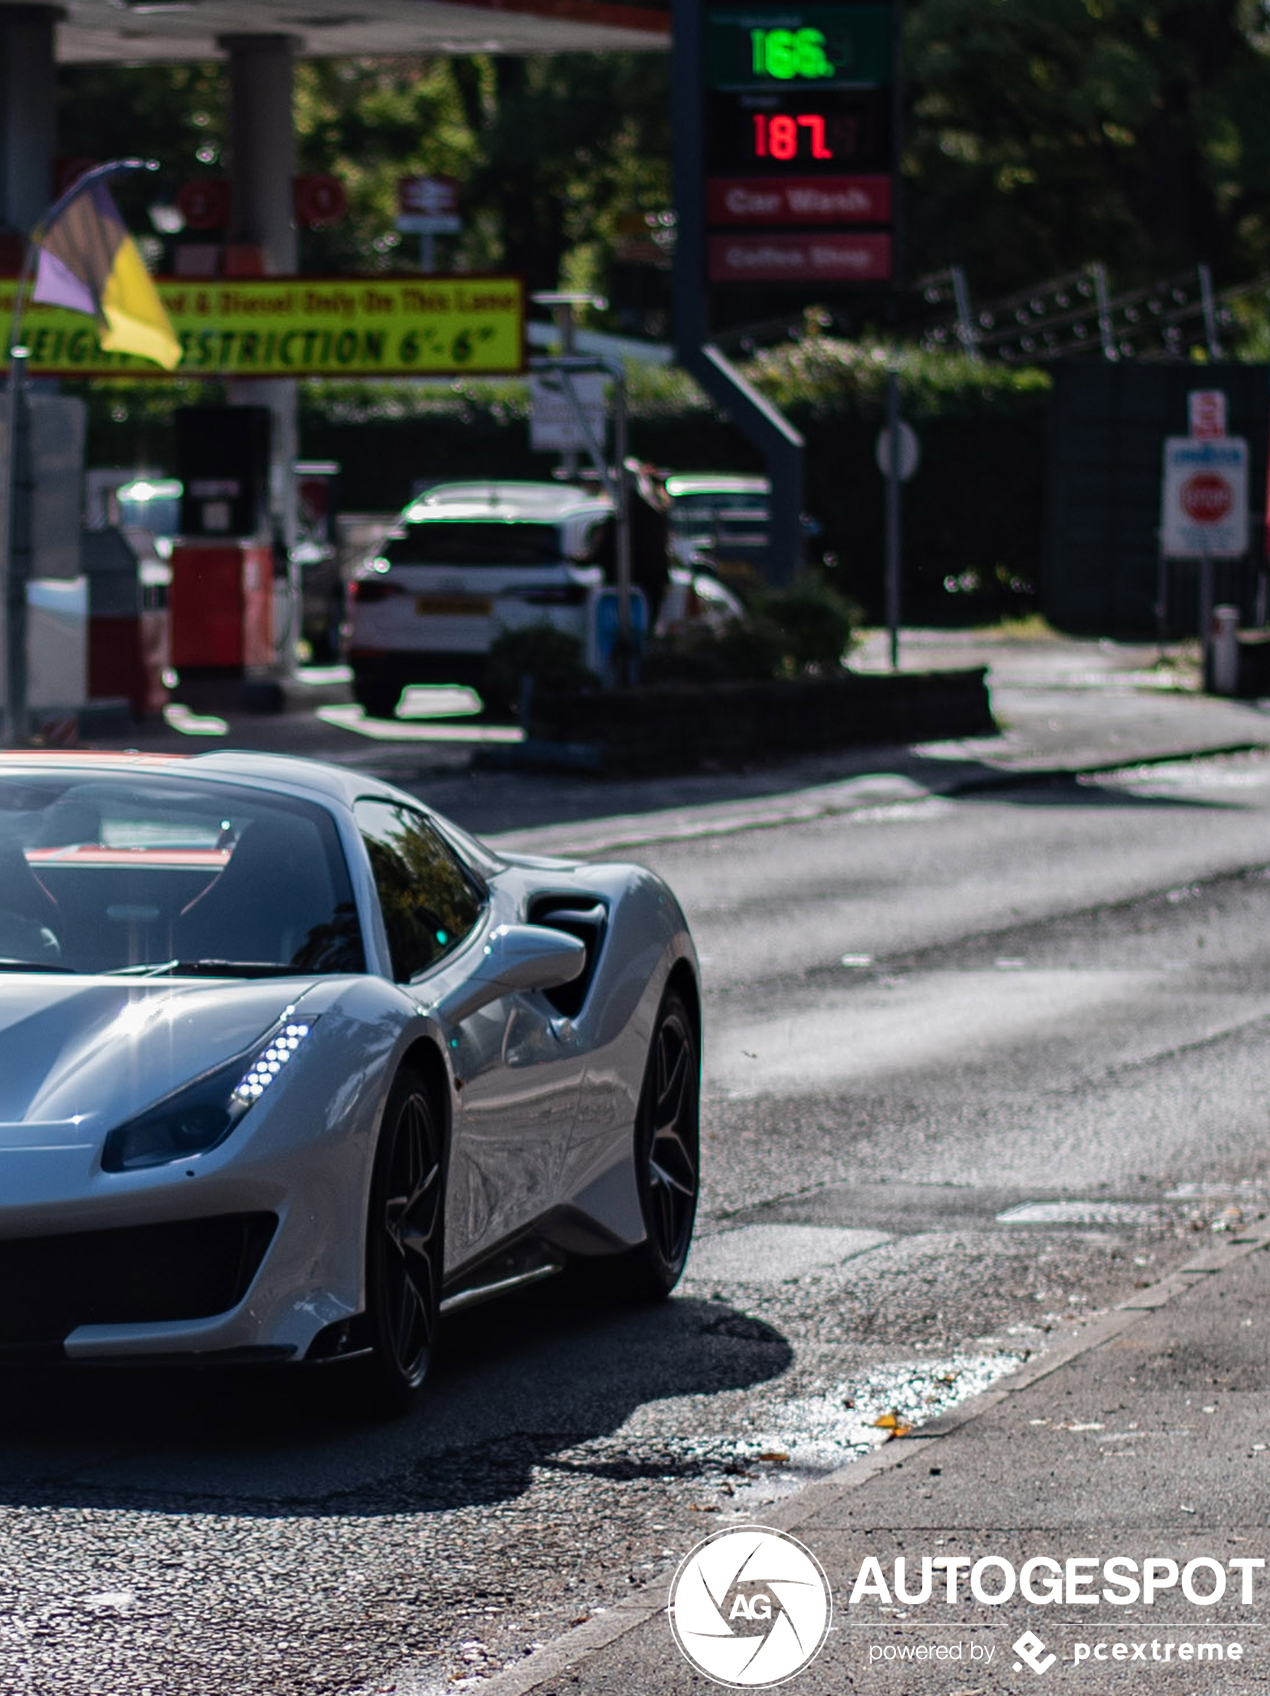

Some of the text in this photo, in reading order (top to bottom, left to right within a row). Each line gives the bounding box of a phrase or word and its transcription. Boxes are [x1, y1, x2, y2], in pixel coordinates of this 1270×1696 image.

[724, 187, 871, 214] Car Wash
[220, 289, 294, 317] Diesel
[302, 288, 355, 322] Only
[364, 288, 395, 316] On
[402, 288, 448, 314] This
[455, 287, 515, 314] Lane
[4, 327, 130, 363] HEIGH
[175, 328, 387, 364] ESTRICTION
